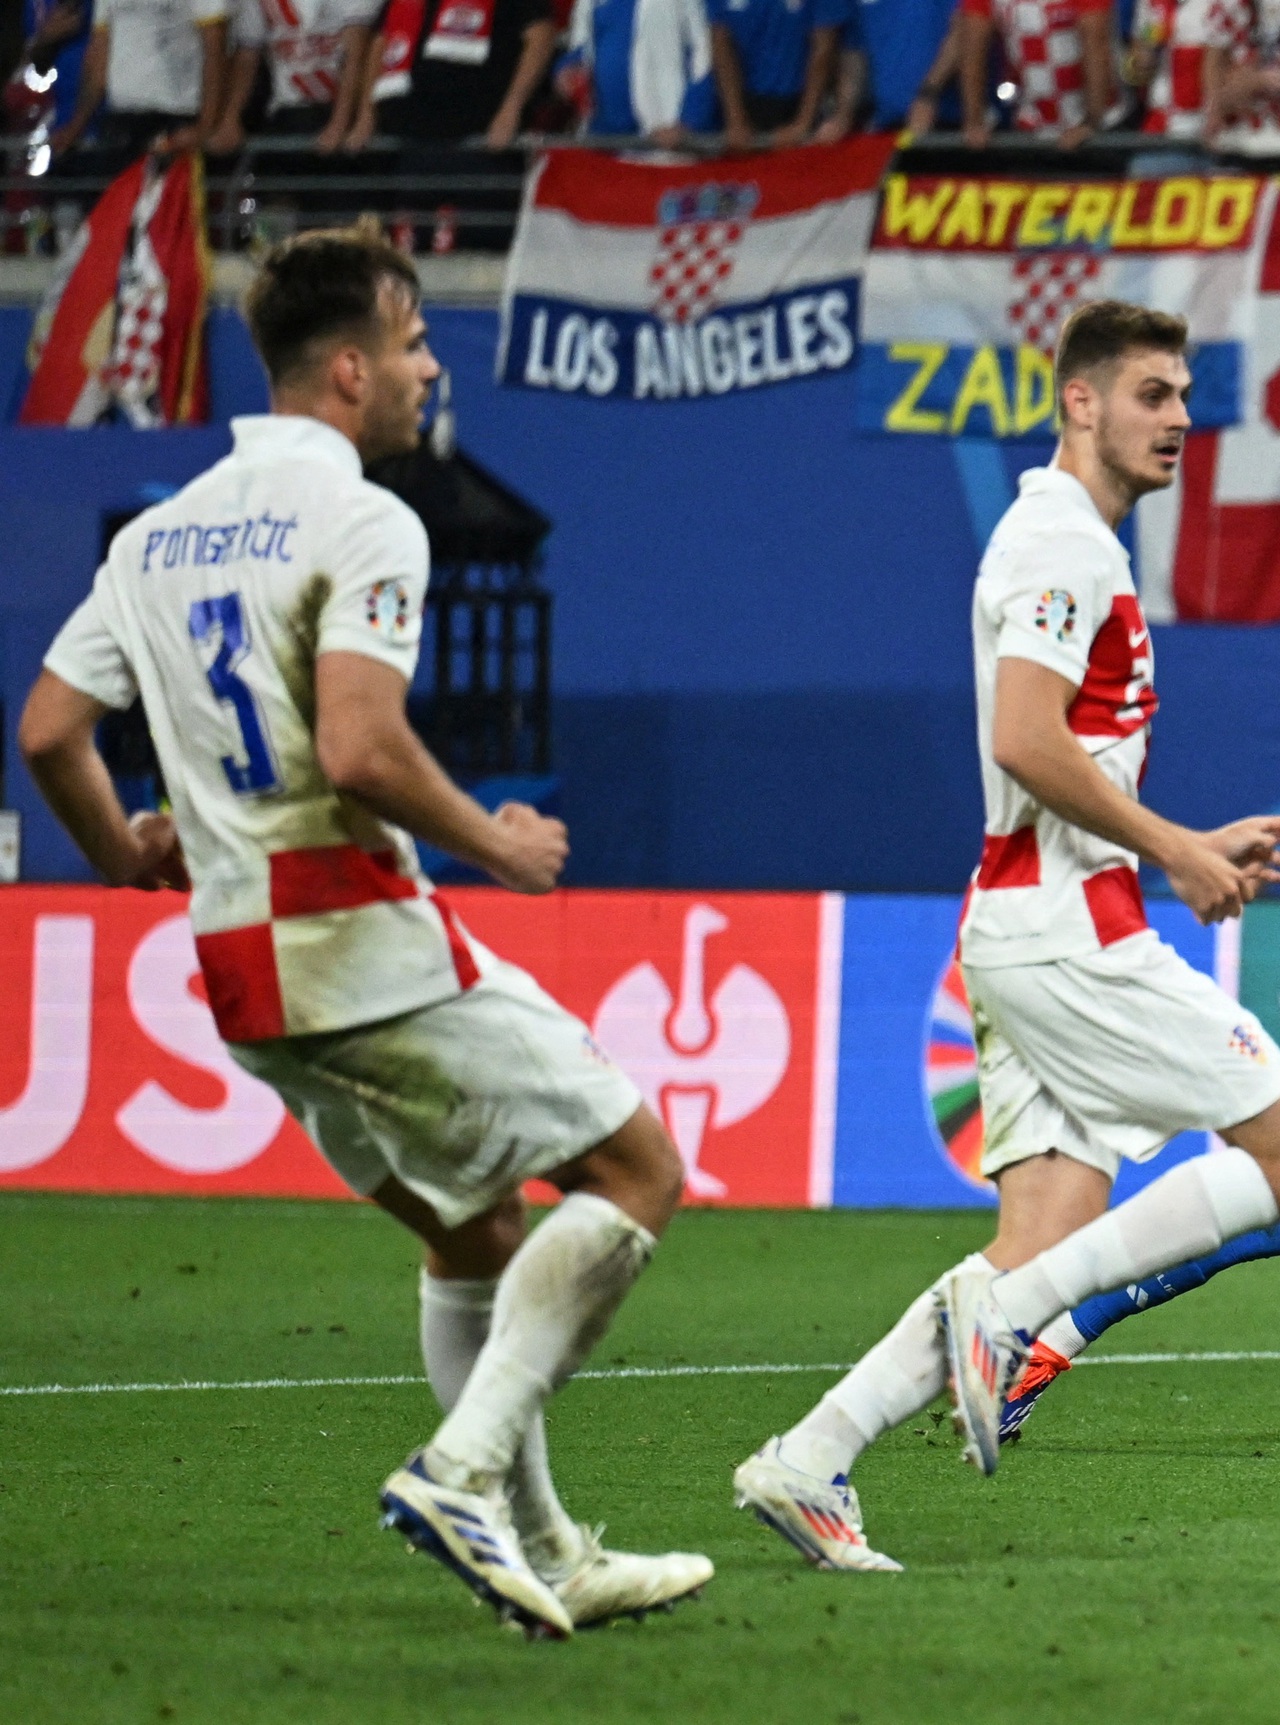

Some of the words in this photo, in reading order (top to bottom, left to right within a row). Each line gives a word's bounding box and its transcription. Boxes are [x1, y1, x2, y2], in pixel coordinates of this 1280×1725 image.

[885, 174, 1257, 246] WATERLOO
[525, 308, 619, 395] LOS
[633, 290, 853, 400] ANGELES
[884, 340, 1060, 436] ZAD
[188, 591, 284, 796] 3
